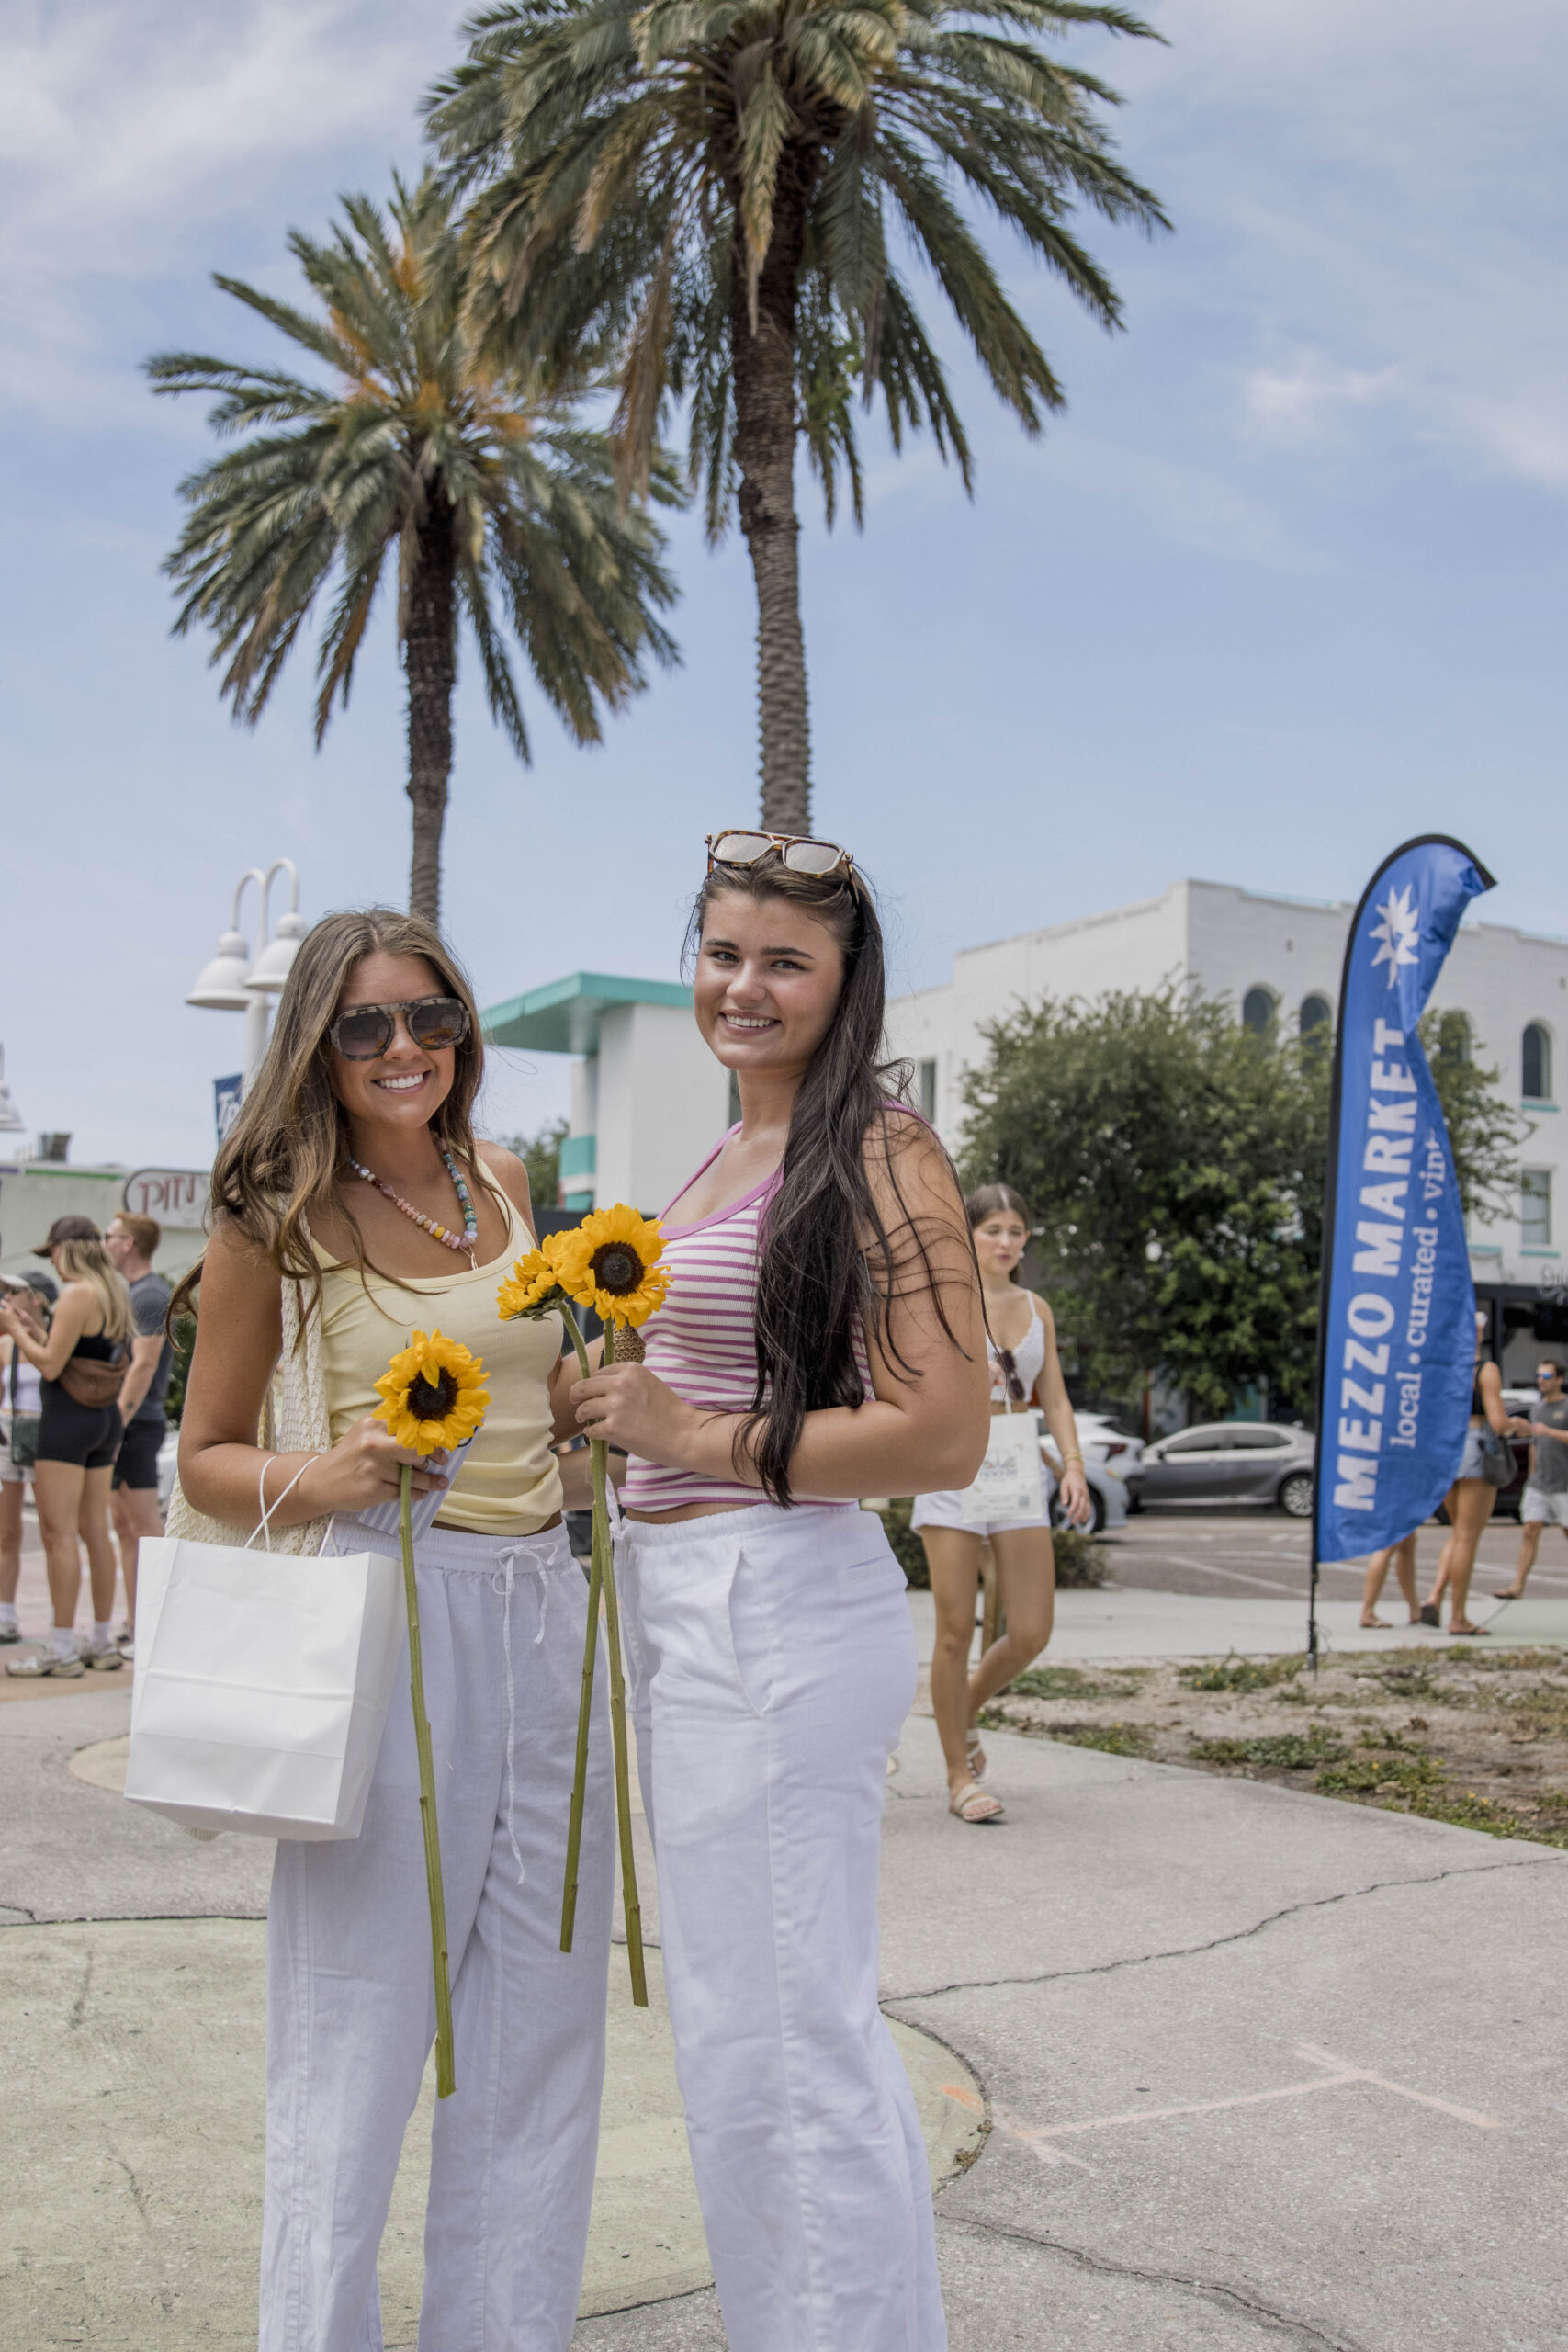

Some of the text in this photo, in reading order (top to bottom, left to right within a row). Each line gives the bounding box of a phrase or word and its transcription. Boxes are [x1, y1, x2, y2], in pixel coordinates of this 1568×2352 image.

[1333, 1017, 1417, 1511] MEZZO MARKET
[1389, 1127, 1446, 1449] local curated vint
